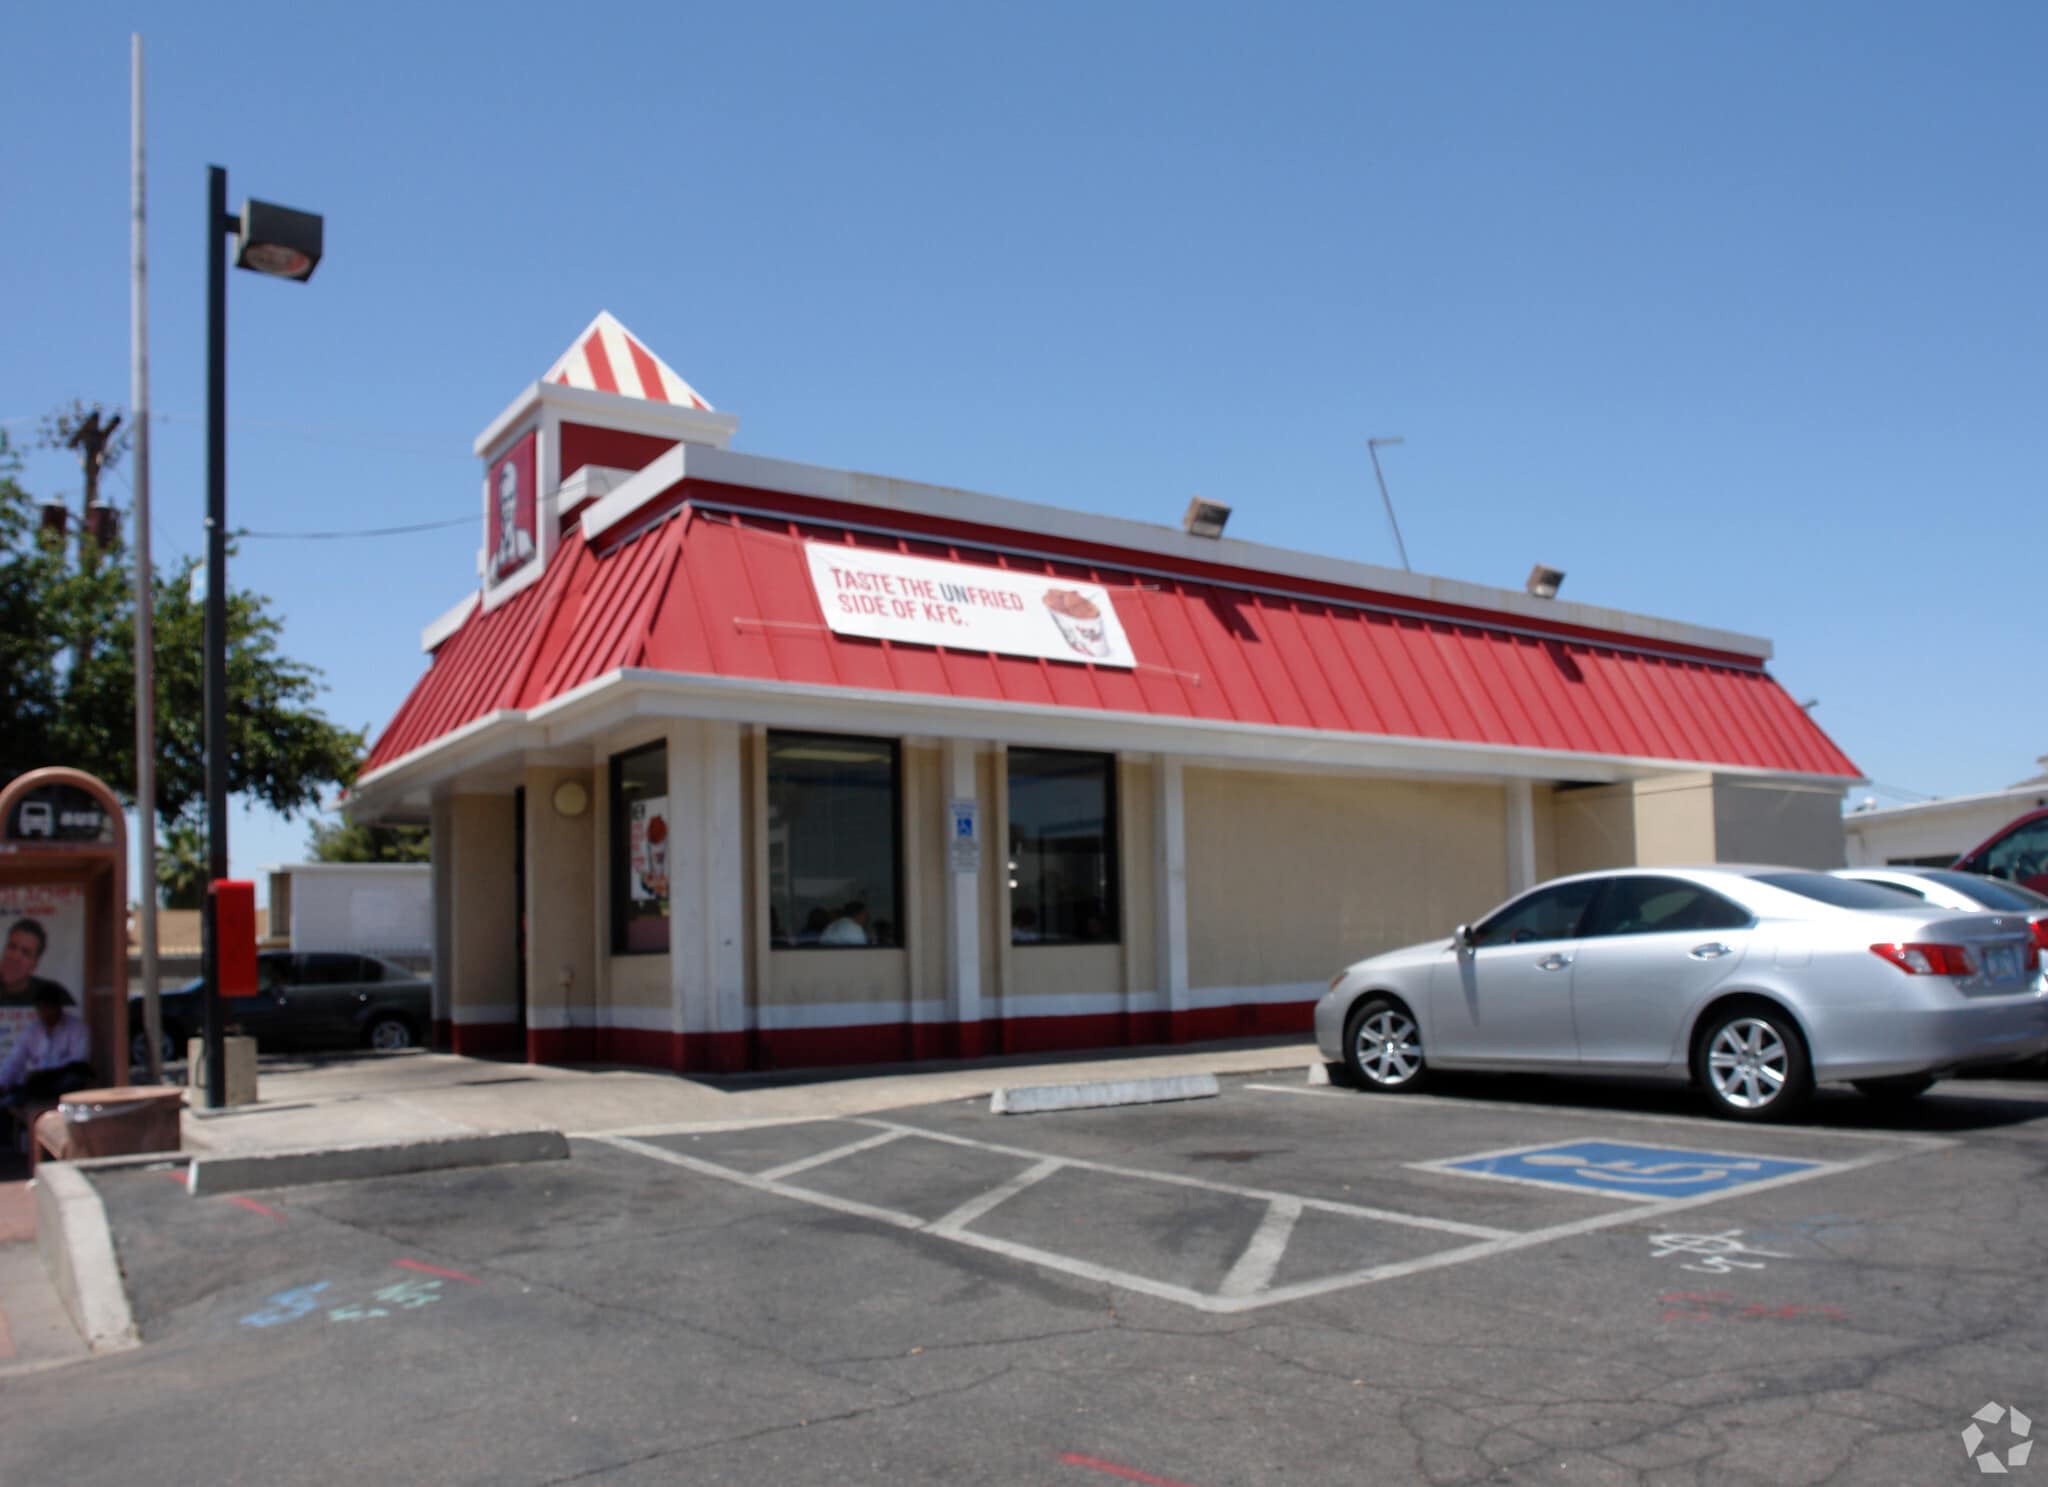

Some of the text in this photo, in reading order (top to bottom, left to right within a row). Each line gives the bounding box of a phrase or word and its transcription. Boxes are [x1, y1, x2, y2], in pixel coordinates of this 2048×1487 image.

[832, 568, 1025, 612] TASTE THE UNFRIED
[837, 593, 970, 627] SIDE OF KFC.
